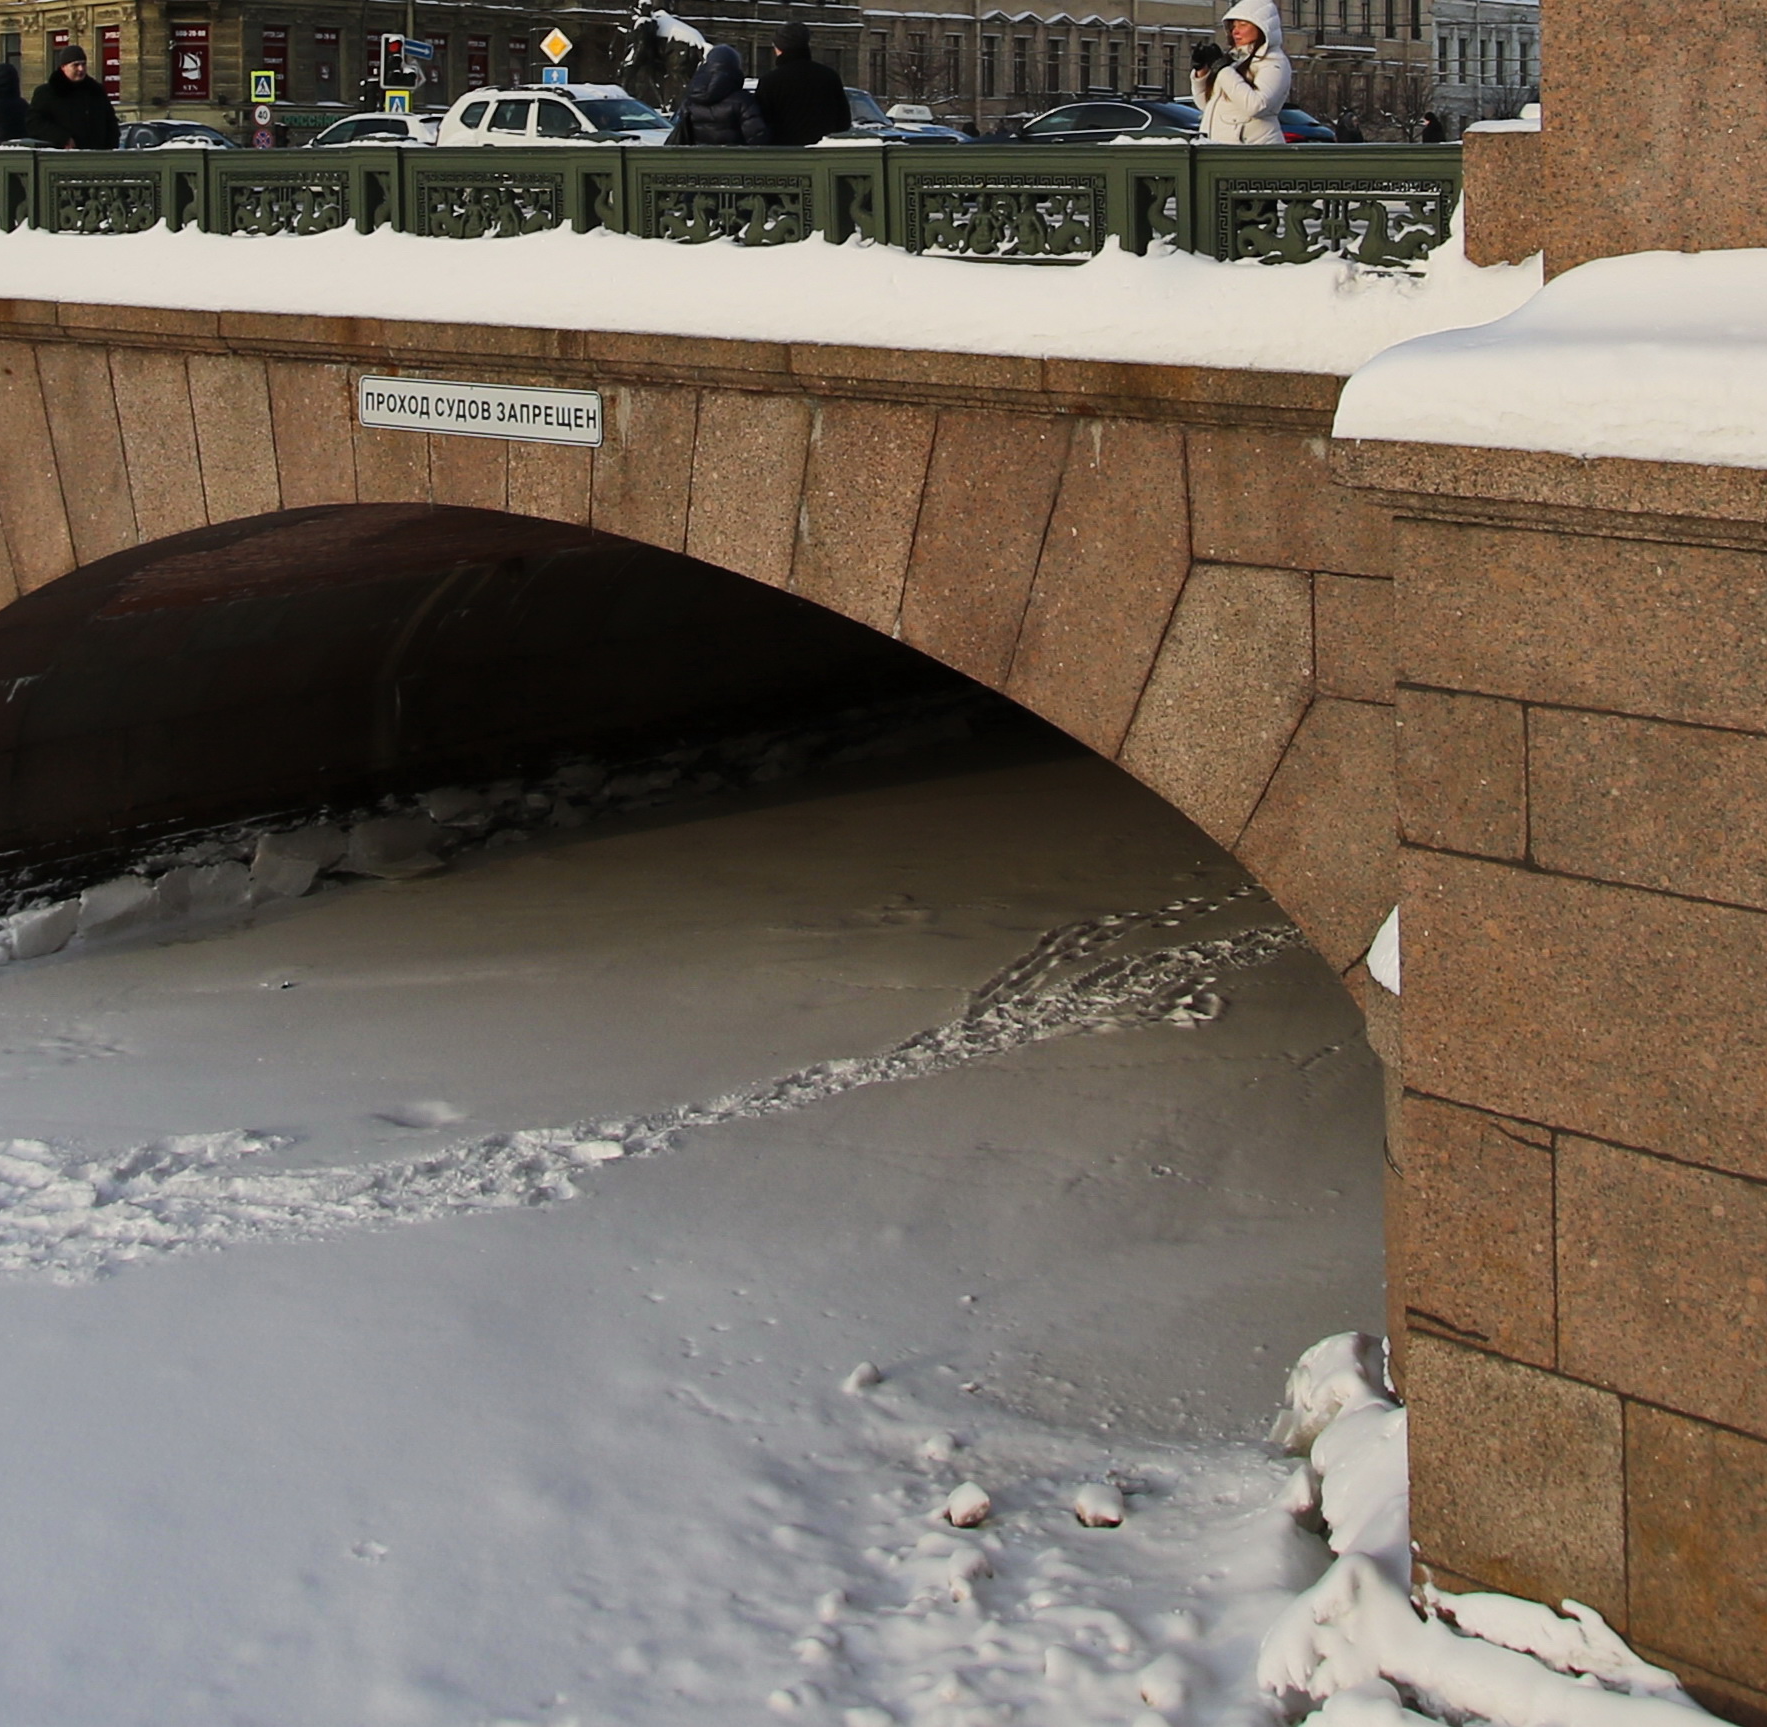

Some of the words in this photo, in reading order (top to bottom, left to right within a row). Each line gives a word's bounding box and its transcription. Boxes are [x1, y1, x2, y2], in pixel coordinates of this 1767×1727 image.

[257, 110, 268, 120] 40
[364, 391, 431, 420] ПРОХОД
[434, 397, 492, 423] СУДОВ
[496, 402, 598, 432] ЗАПРЕЩЕН
